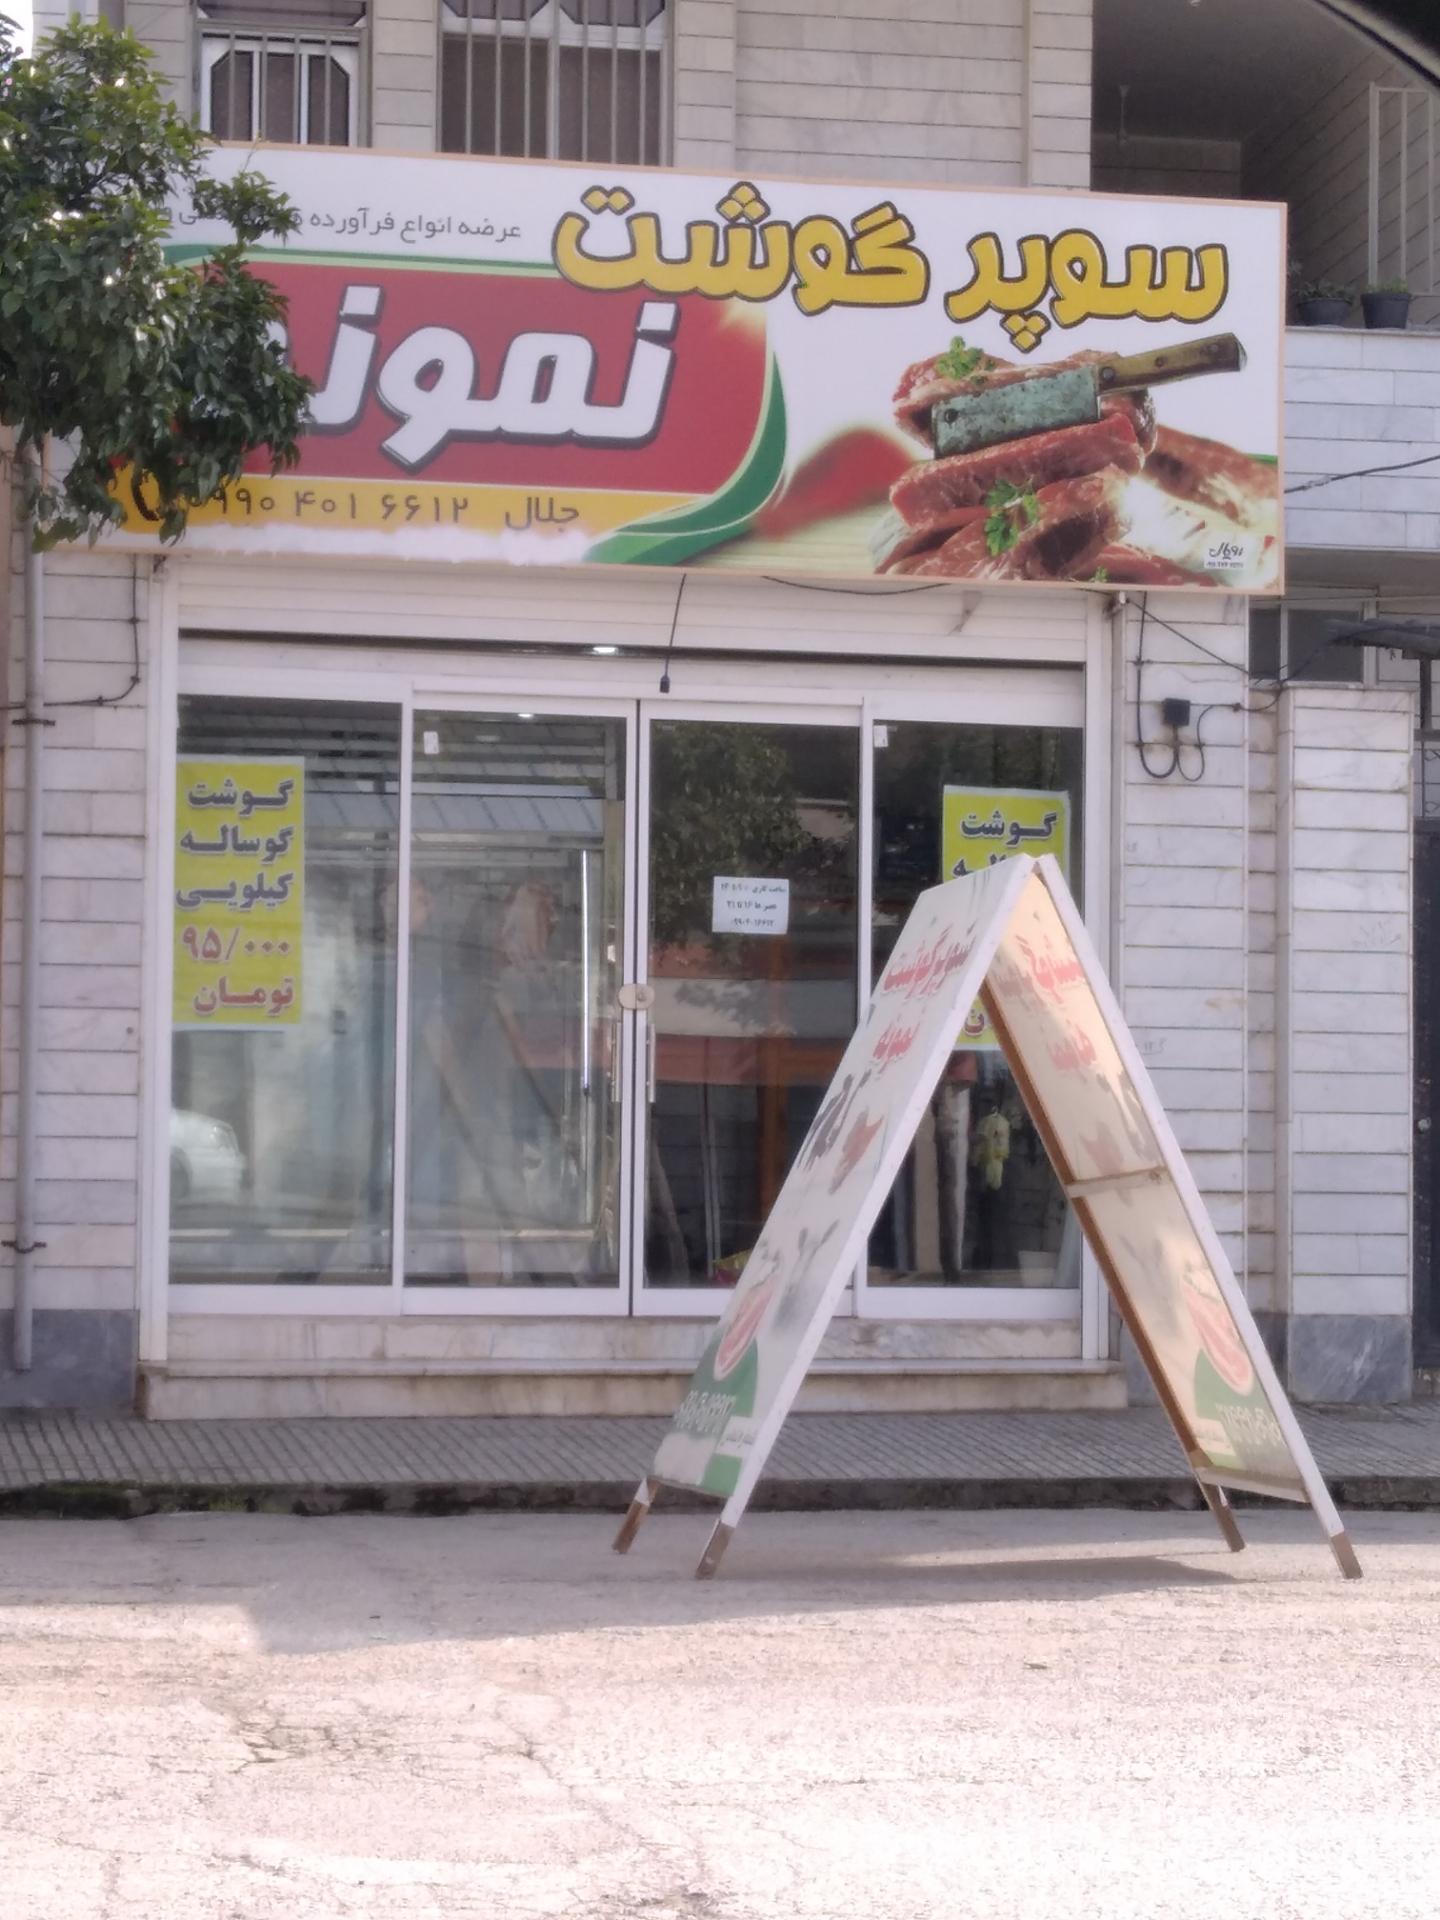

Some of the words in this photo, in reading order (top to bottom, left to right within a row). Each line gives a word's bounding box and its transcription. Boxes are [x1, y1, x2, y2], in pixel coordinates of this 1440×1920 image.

[310, 206, 395, 236] فرآورده
[400, 214, 451, 244] انواع
[458, 217, 521, 242] عرضه
[552, 181, 930, 315] گوشت
[944, 228, 1229, 353] سوپر
[381, 493, 469, 524] ۶۶۱۲
[504, 496, 580, 533] جلال
[187, 778, 294, 817] گوشت
[179, 824, 294, 863] گوساله
[961, 810, 1058, 847] گوشت
[175, 872, 294, 909] کیلویی
[193, 975, 294, 1015] تومان
